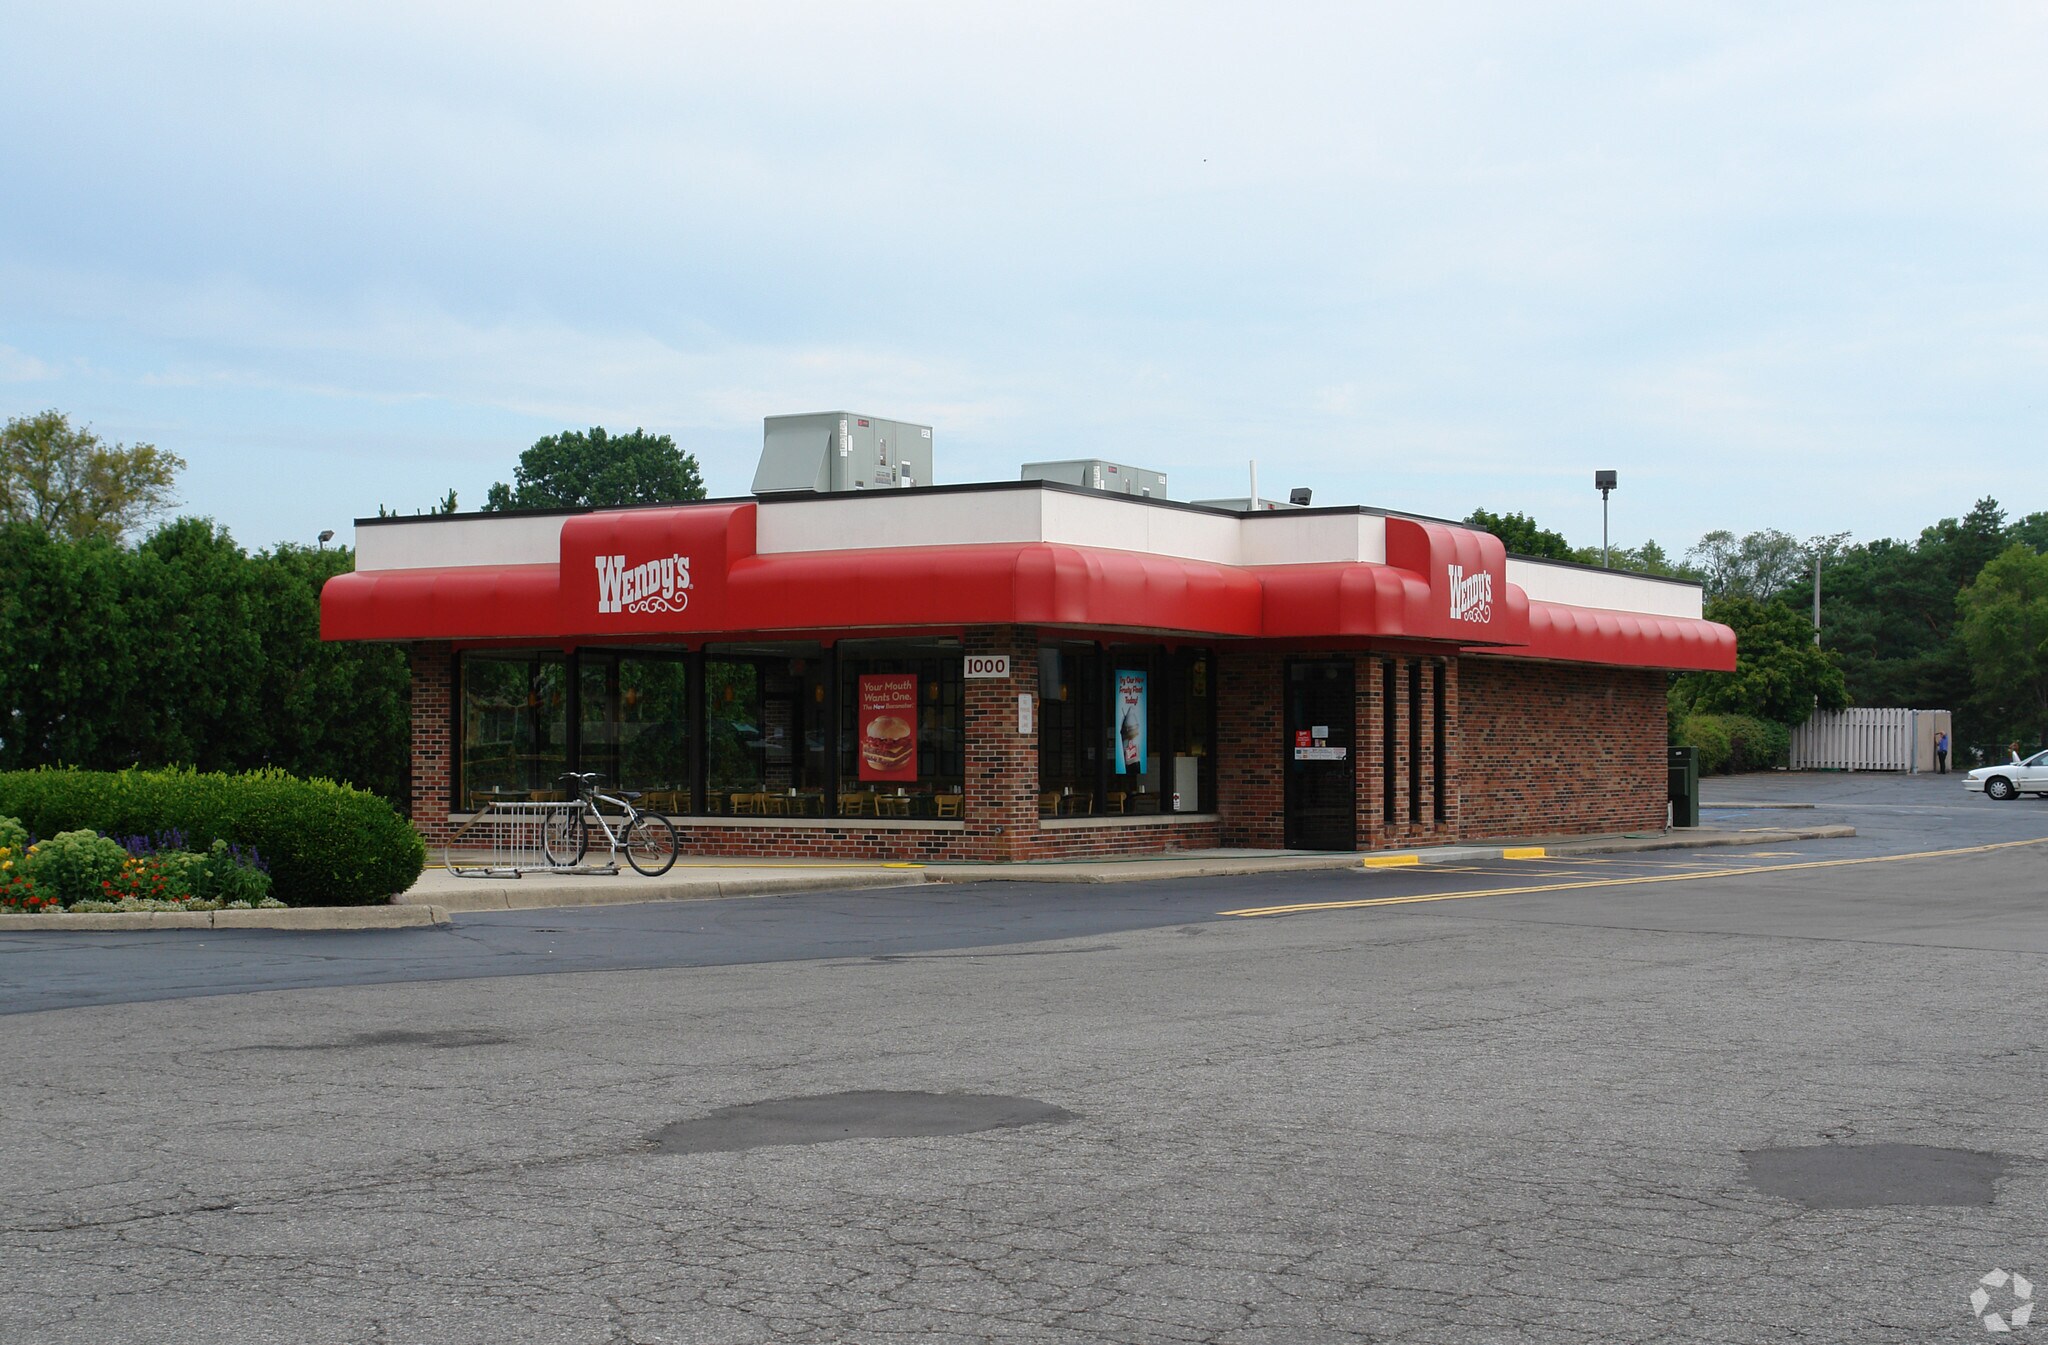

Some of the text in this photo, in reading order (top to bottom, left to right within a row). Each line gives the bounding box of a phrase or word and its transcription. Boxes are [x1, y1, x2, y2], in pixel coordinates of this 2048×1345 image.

[967, 659, 1005, 674] 1000
[864, 680, 912, 691] Your Mouth
[864, 691, 912, 702] Wants One.
